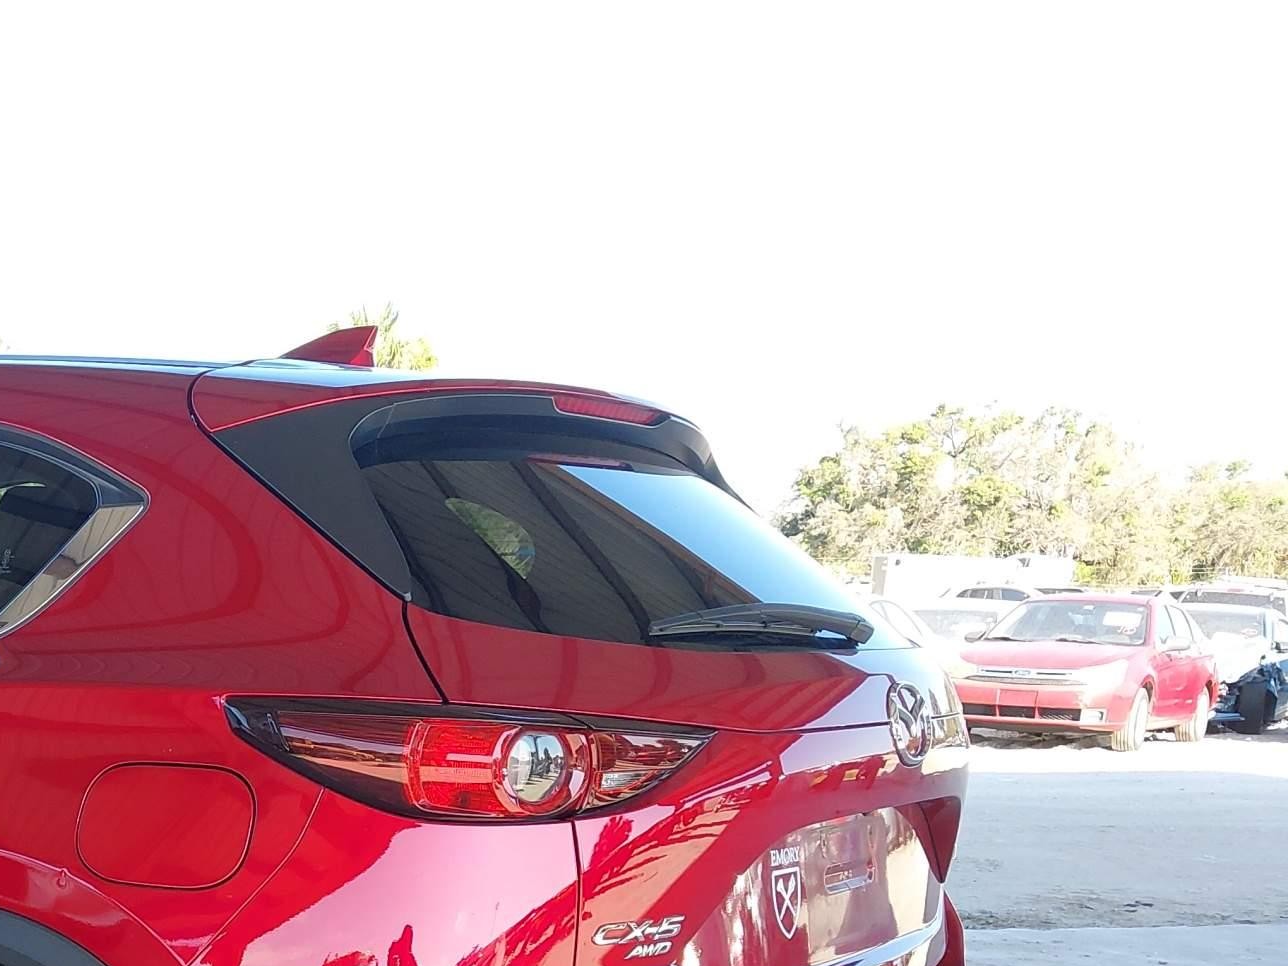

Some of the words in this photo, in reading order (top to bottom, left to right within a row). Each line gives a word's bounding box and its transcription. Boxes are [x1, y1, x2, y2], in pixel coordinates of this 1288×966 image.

[770, 846, 800, 867] EMORY
[593, 915, 684, 945] CX-5
[623, 942, 672, 959] AWD
